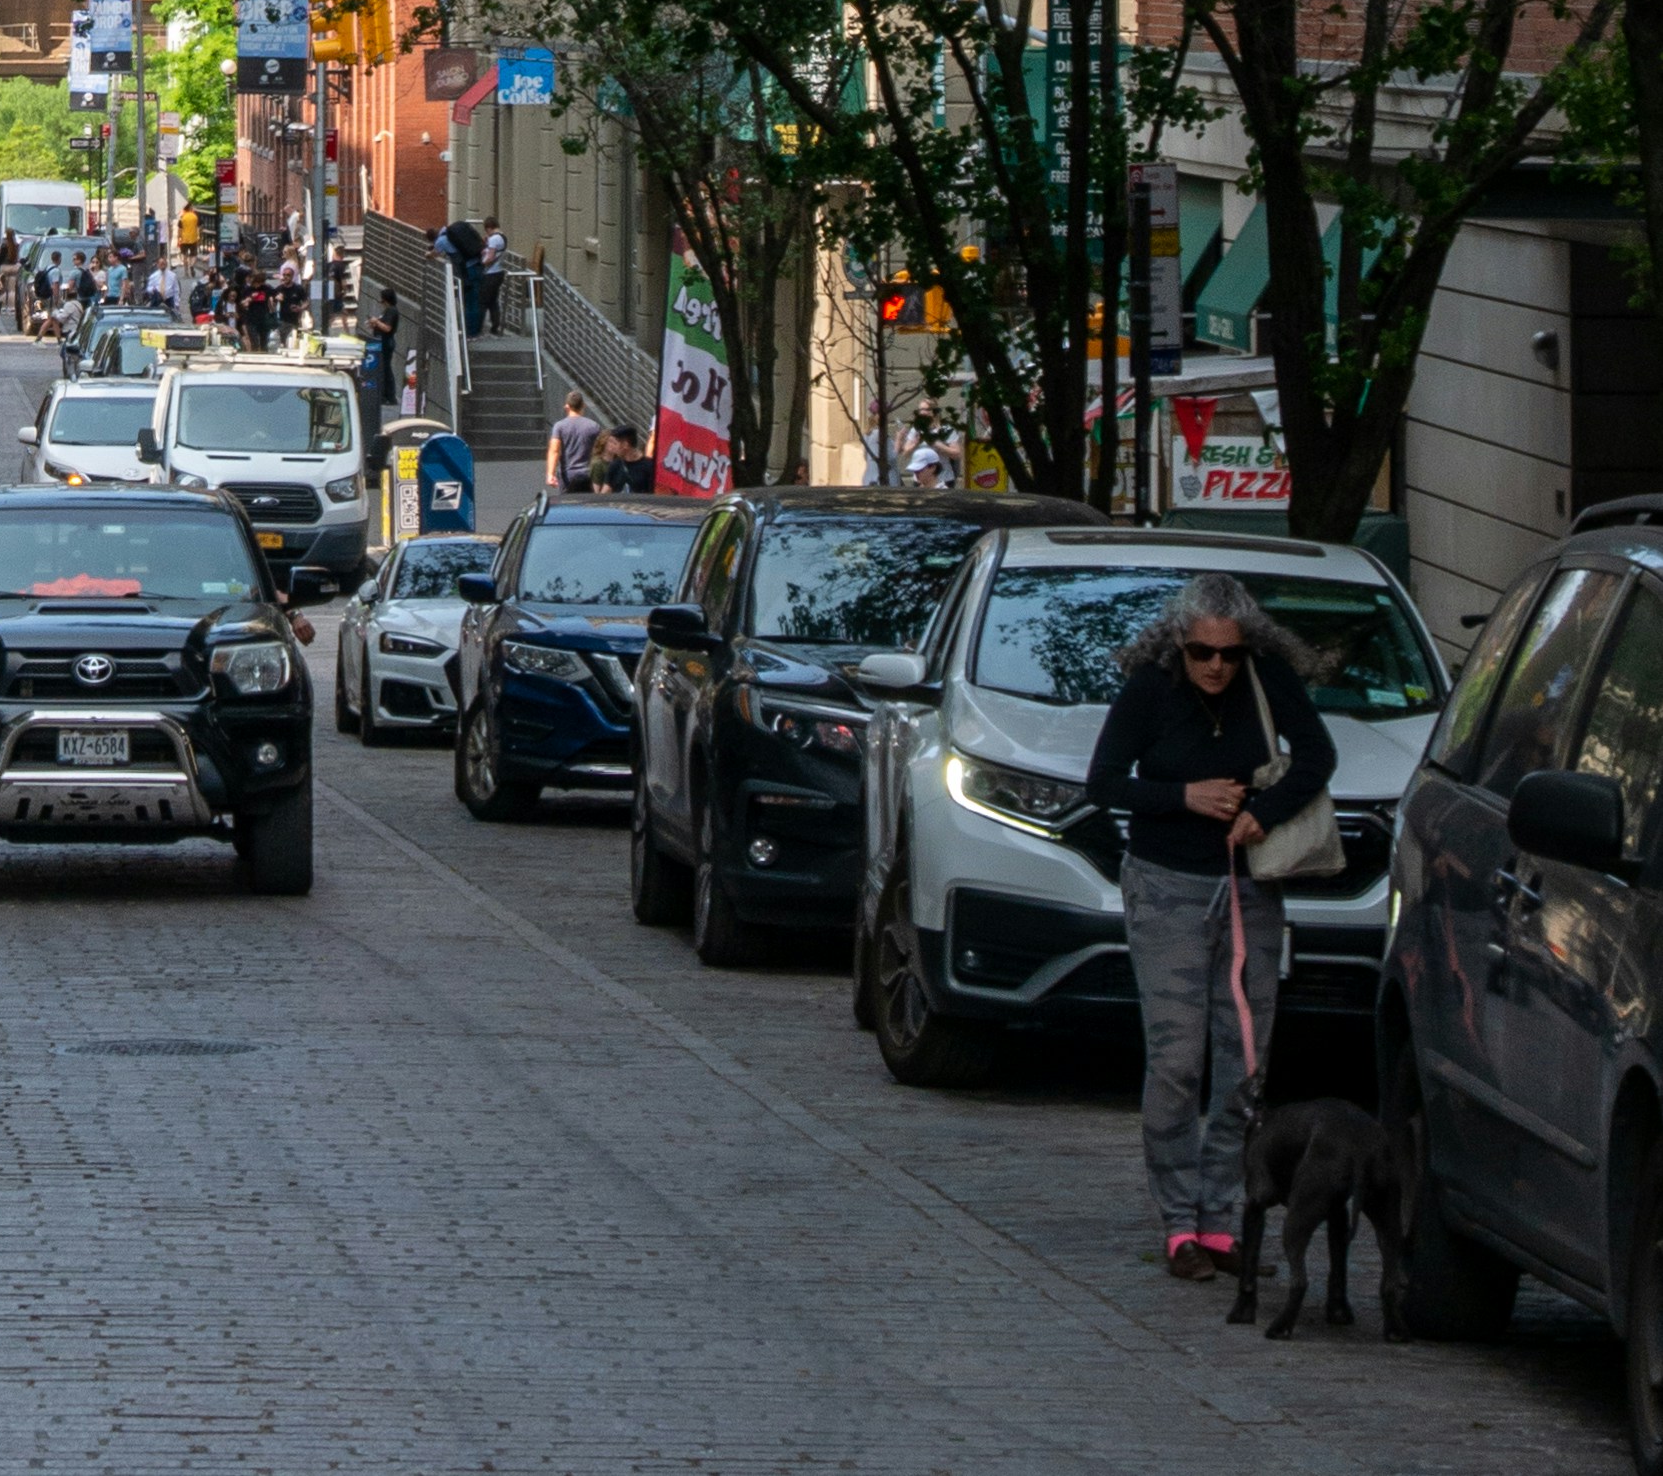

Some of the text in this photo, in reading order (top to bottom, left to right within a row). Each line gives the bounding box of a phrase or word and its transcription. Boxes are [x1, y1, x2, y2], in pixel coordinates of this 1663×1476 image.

[240, 0, 294, 21] DRP
[511, 73, 544, 91] Joe
[262, 236, 279, 251] 25
